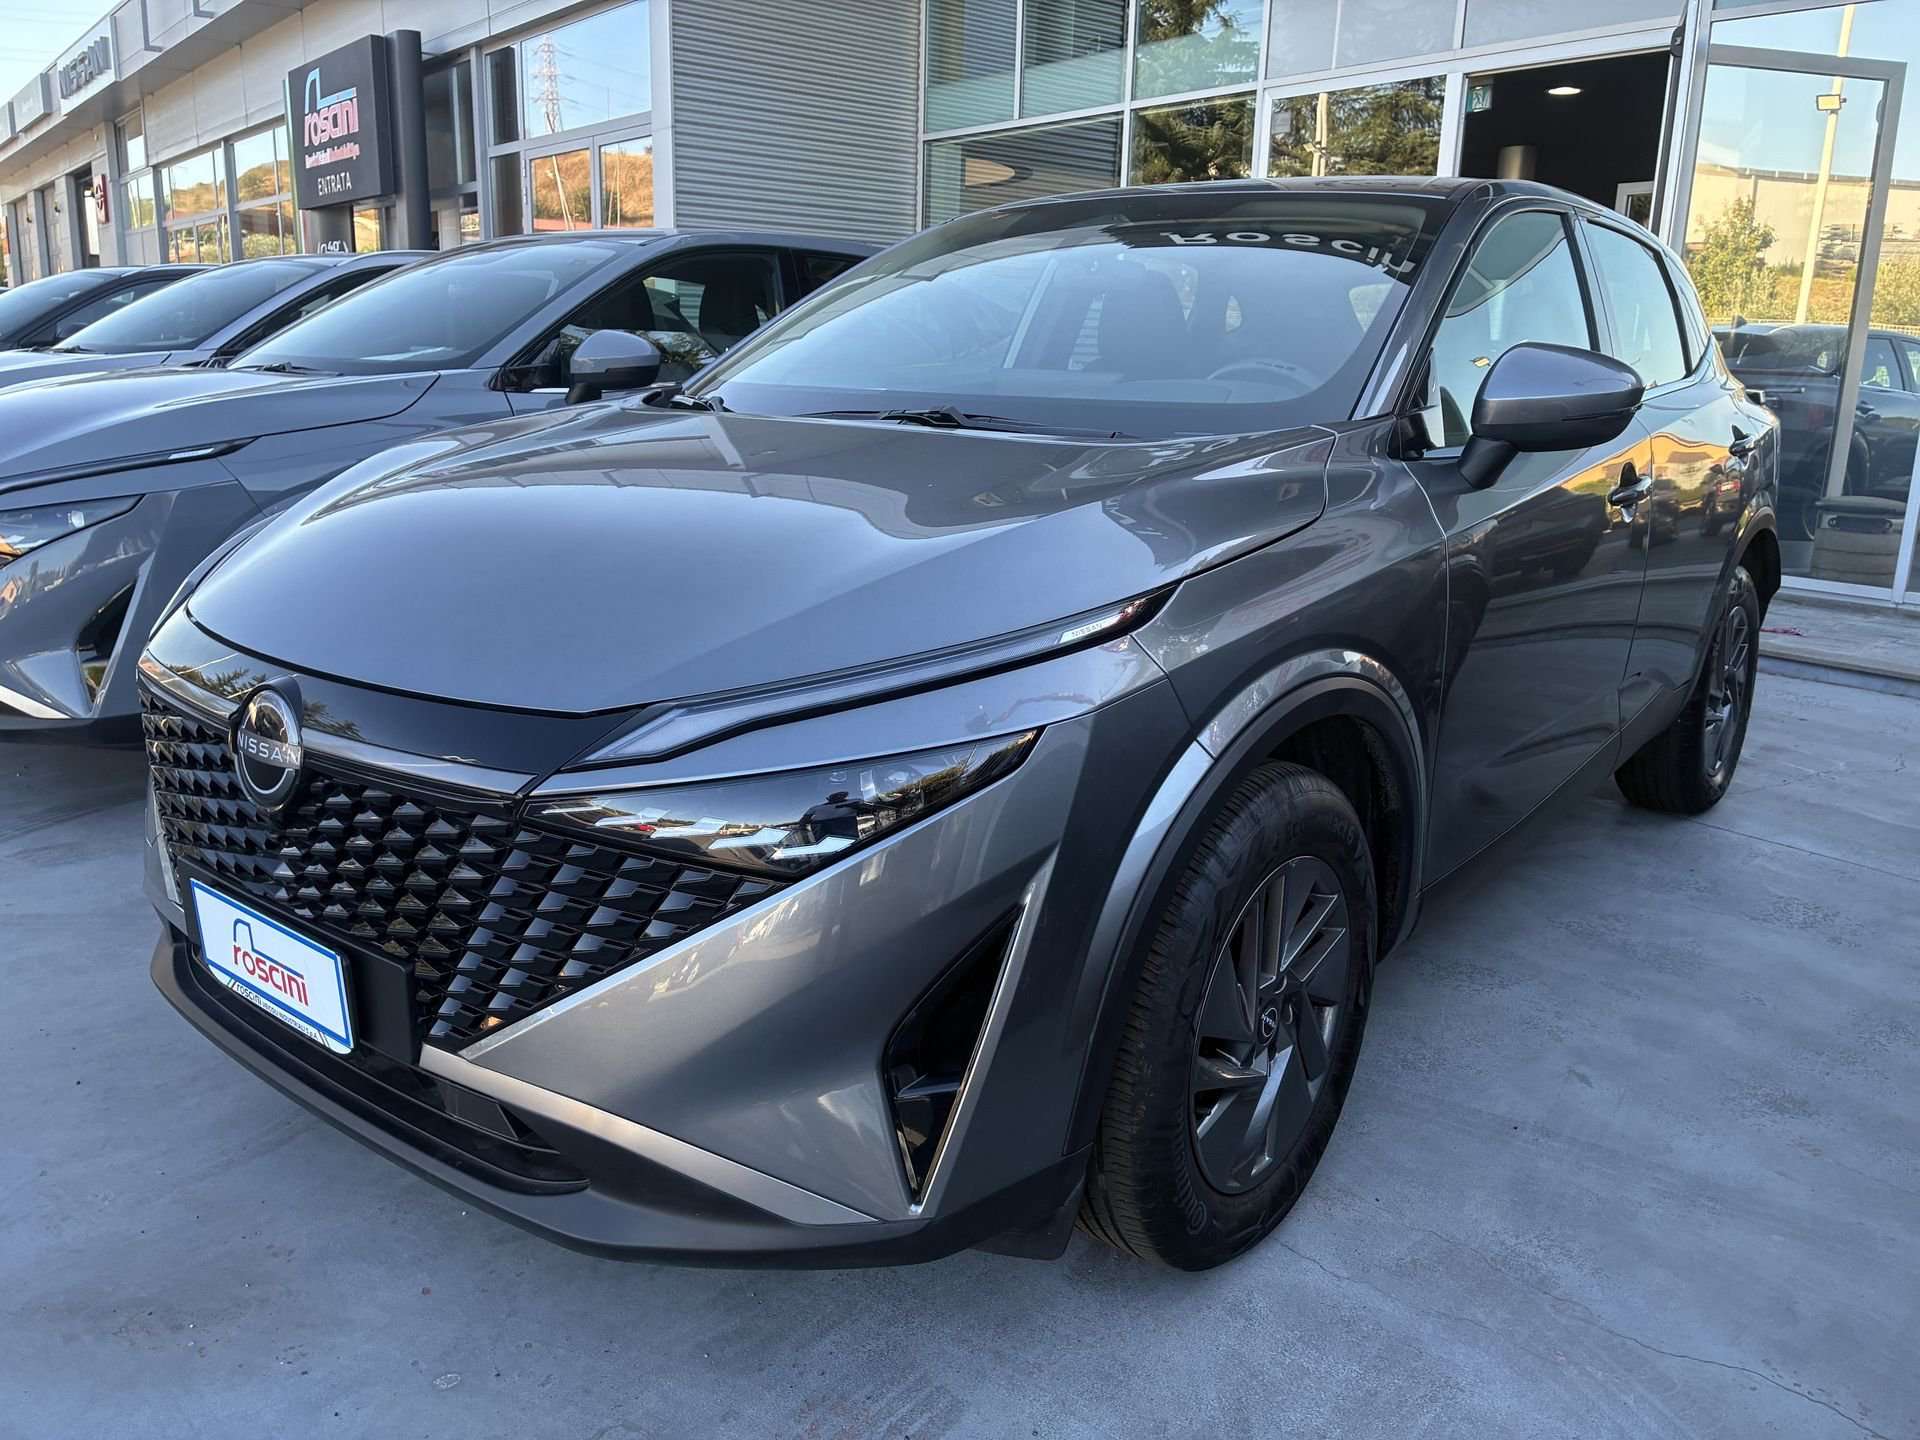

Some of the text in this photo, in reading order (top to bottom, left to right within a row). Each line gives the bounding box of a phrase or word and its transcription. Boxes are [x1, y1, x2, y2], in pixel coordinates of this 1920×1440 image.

[317, 171, 352, 195] ENTRATA
[237, 729, 301, 766] NISSAN
[233, 944, 309, 1006] roscini
